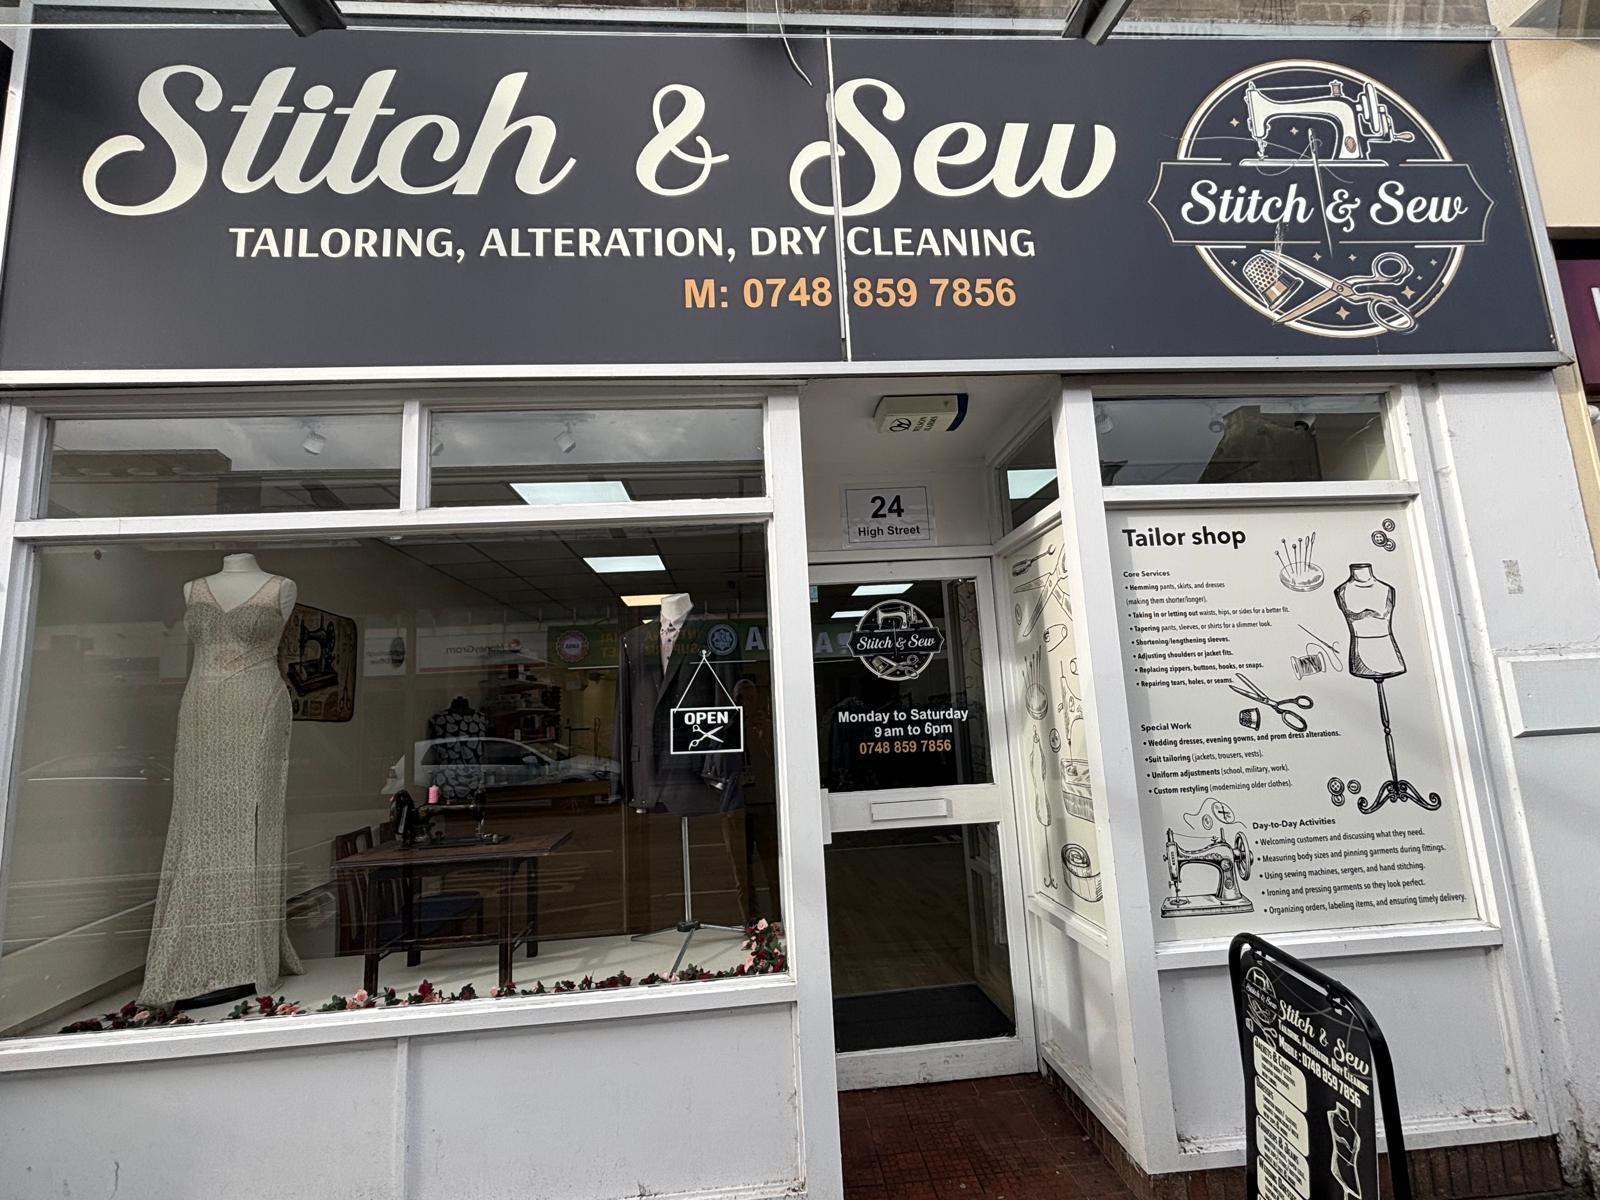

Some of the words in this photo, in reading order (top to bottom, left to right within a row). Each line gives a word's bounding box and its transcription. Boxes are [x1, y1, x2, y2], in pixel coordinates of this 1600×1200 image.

[82, 64, 577, 216] Stitch
[635, 83, 729, 196] &
[789, 78, 1116, 216] Sew
[1181, 179, 1314, 225] Stitch
[1326, 189, 1361, 233] &
[1369, 180, 1468, 226] Sew
[229, 227, 466, 262] TAILORING,
[479, 227, 736, 262] ALTERATION,
[750, 226, 827, 256] DRY
[846, 226, 1036, 257] CLEANING
[684, 278, 729, 308] M:
[743, 277, 832, 307] 0748
[853, 278, 918, 307] 859
[929, 277, 1016, 307] 7856
[870, 495, 904, 519] 24
[858, 526, 884, 538] High
[887, 525, 920, 535] Street
[1122, 527, 1186, 547] Tailor
[1192, 526, 1246, 550] shop
[1141, 569, 1170, 577] Services
[1129, 584, 1159, 592] Hemming
[1205, 581, 1226, 589] dresses
[857, 636, 893, 650] Stitch
[895, 637, 906, 650] &
[908, 634, 935, 648] Sew
[1138, 652, 1167, 661] Adjusting
[1167, 650, 1197, 659] shoulders
[1204, 650, 1222, 659] jacket
[1139, 666, 1169, 675] Replacing
[1141, 679, 1170, 689] Repairing
[684, 711, 728, 725] OPEN
[838, 711, 890, 724] Monday
[894, 710, 907, 721] to
[910, 708, 968, 722] Saturday
[907, 724, 920, 735] to
[924, 722, 952, 736] 6pm
[1141, 723, 1170, 734] Special
[1170, 722, 1192, 730] Work
[859, 742, 890, 754] 0748
[894, 741, 917, 753] 859
[921, 739, 951, 752] 7856
[1148, 738, 1178, 748] Wedding
[1206, 735, 1232, 745] evening
[1257, 733, 1269, 741] and
[1270, 734, 1287, 742] prom
[1288, 731, 1305, 739] dress
[1148, 755, 1162, 764] Suit
[1162, 754, 1192, 763] tailoring
[1152, 770, 1179, 779] Uniform
[1180, 769, 1221, 779] adjustments
[1154, 787, 1179, 795] Custom
[1180, 784, 1209, 795] restyling
[1251, 780, 1267, 789] older
[1252, 820, 1298, 832] Day-to-Day
[1299, 817, 1336, 827] Activities
[1259, 836, 1296, 846] Welcoming
[1296, 835, 1329, 844] customers
[1330, 832, 1342, 842] and
[1342, 831, 1376, 841] discussing
[1376, 830, 1392, 838] what
[1392, 829, 1406, 839] they
[1262, 854, 1297, 863] Measuring
[1296, 852, 1313, 862] body
[1314, 851, 1330, 860] sizes
[1330, 849, 1343, 858] and
[1344, 848, 1369, 859] pinning
[1369, 846, 1400, 858] garments
[1400, 845, 1422, 855] during
[1264, 871, 1284, 881] Using
[1284, 869, 1308, 879] sewing
[1366, 863, 1379, 873] and
[1379, 862, 1396, 872] hand
[1266, 887, 1291, 898] Ironing
[1291, 886, 1304, 895] and
[1304, 884, 1332, 896] pressing
[1332, 883, 1364, 894] garments
[1372, 881, 1386, 891] they
[1386, 879, 1402, 888] look
[1269, 904, 1305, 916] Organizing
[1328, 901, 1355, 911] labeling
[1376, 897, 1388, 907] and
[1389, 896, 1418, 906] ensuring
[1418, 893, 1438, 905] timely
[1279, 1000, 1315, 1038] Stitch
[1319, 1027, 1329, 1047] &
[1333, 1038, 1370, 1075] Sew
[1302, 1052, 1322, 1079] 0748
[1322, 1067, 1338, 1091] 859
[1339, 1079, 1361, 1108] 7856
